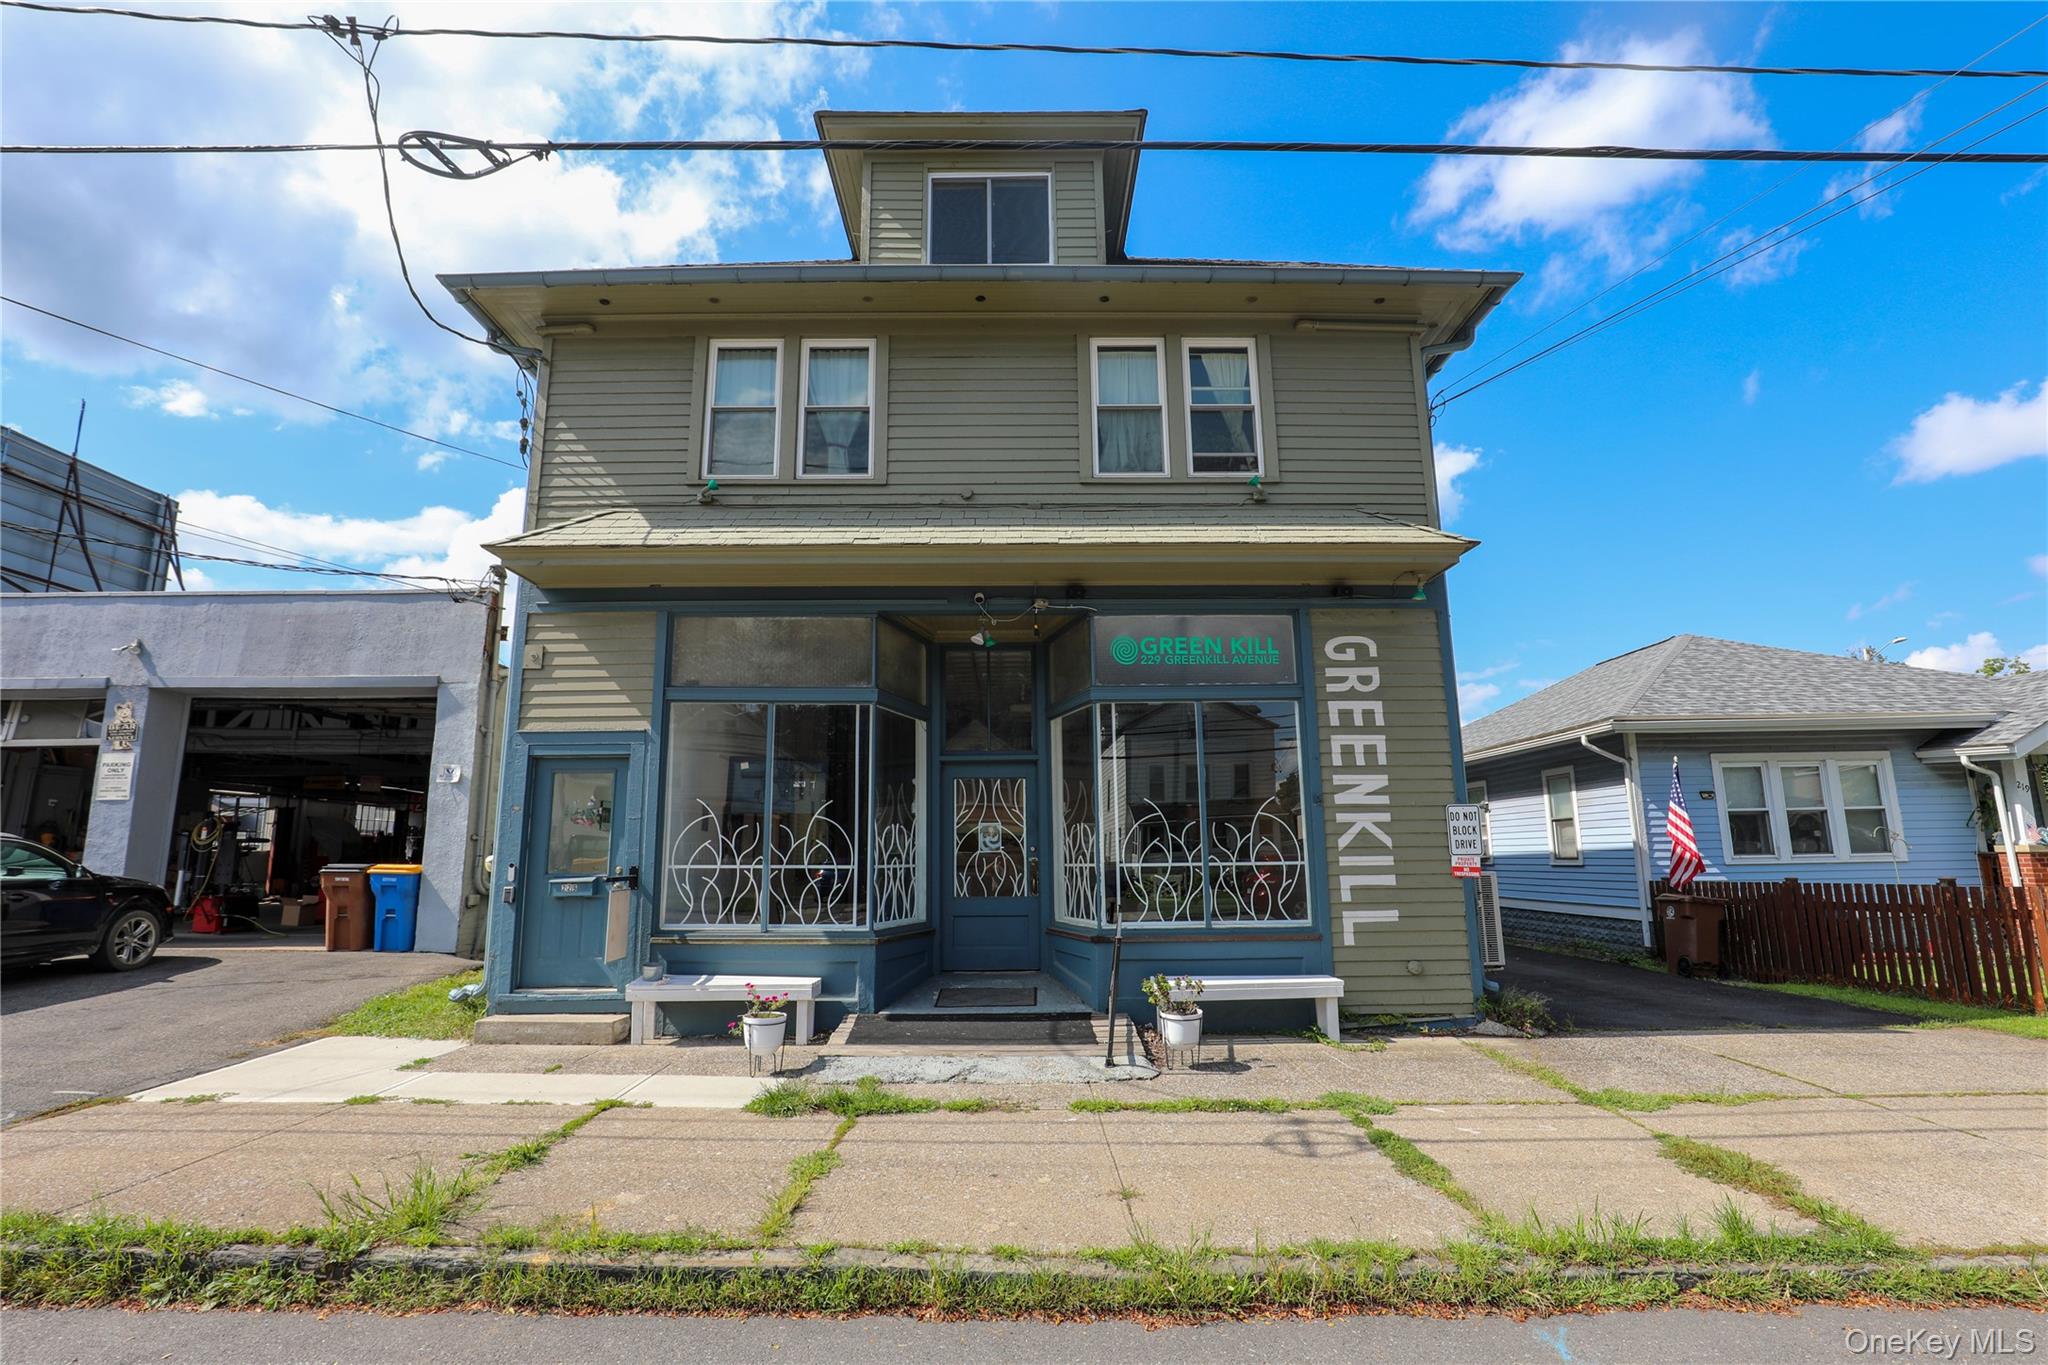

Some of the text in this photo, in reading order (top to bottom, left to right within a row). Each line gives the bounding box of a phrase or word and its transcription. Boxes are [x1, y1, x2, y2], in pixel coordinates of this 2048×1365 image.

[1140, 637, 1280, 655] GREEN KILL
[1140, 655, 1280, 665] 229 GREENKILL AVENUE
[108, 723, 136, 731] BEAR
[1324, 635, 1399, 946] GREENKILL
[2016, 781, 2030, 793] 219
[1450, 811, 1477, 821] DO NOT
[1453, 825, 1478, 835] BLOCK
[1455, 839, 1477, 849] DRIVE
